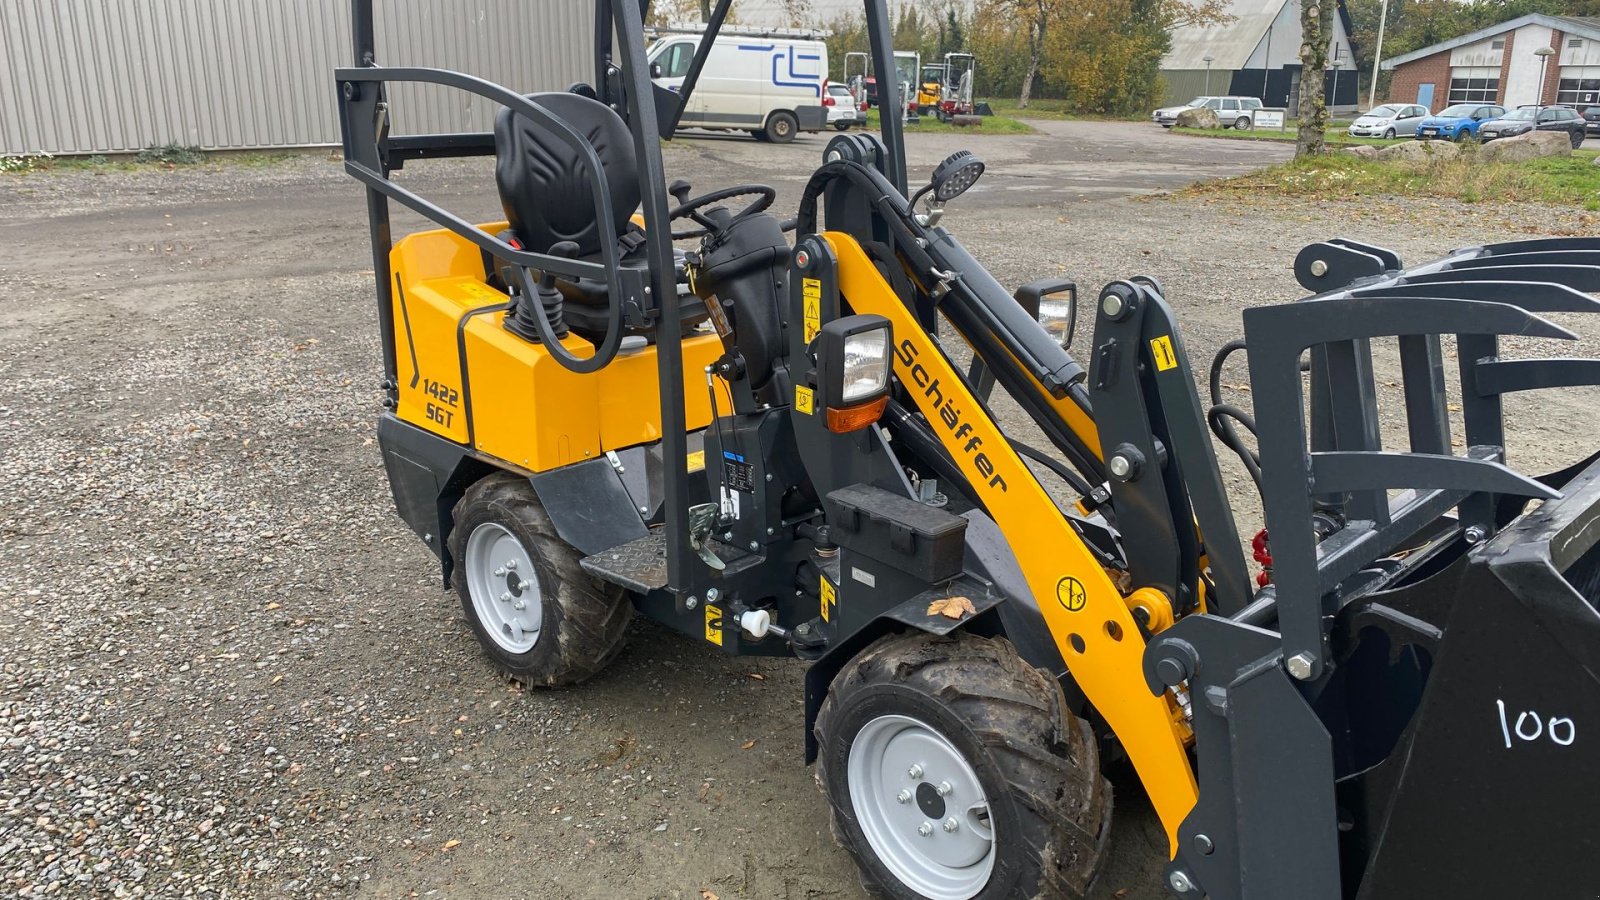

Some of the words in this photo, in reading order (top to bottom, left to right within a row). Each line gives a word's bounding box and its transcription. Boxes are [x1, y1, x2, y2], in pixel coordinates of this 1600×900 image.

[424, 378, 459, 408] 1422
[426, 402, 454, 429] SGT
[893, 339, 1008, 493] Schäffer
[1496, 699, 1575, 748] 100
